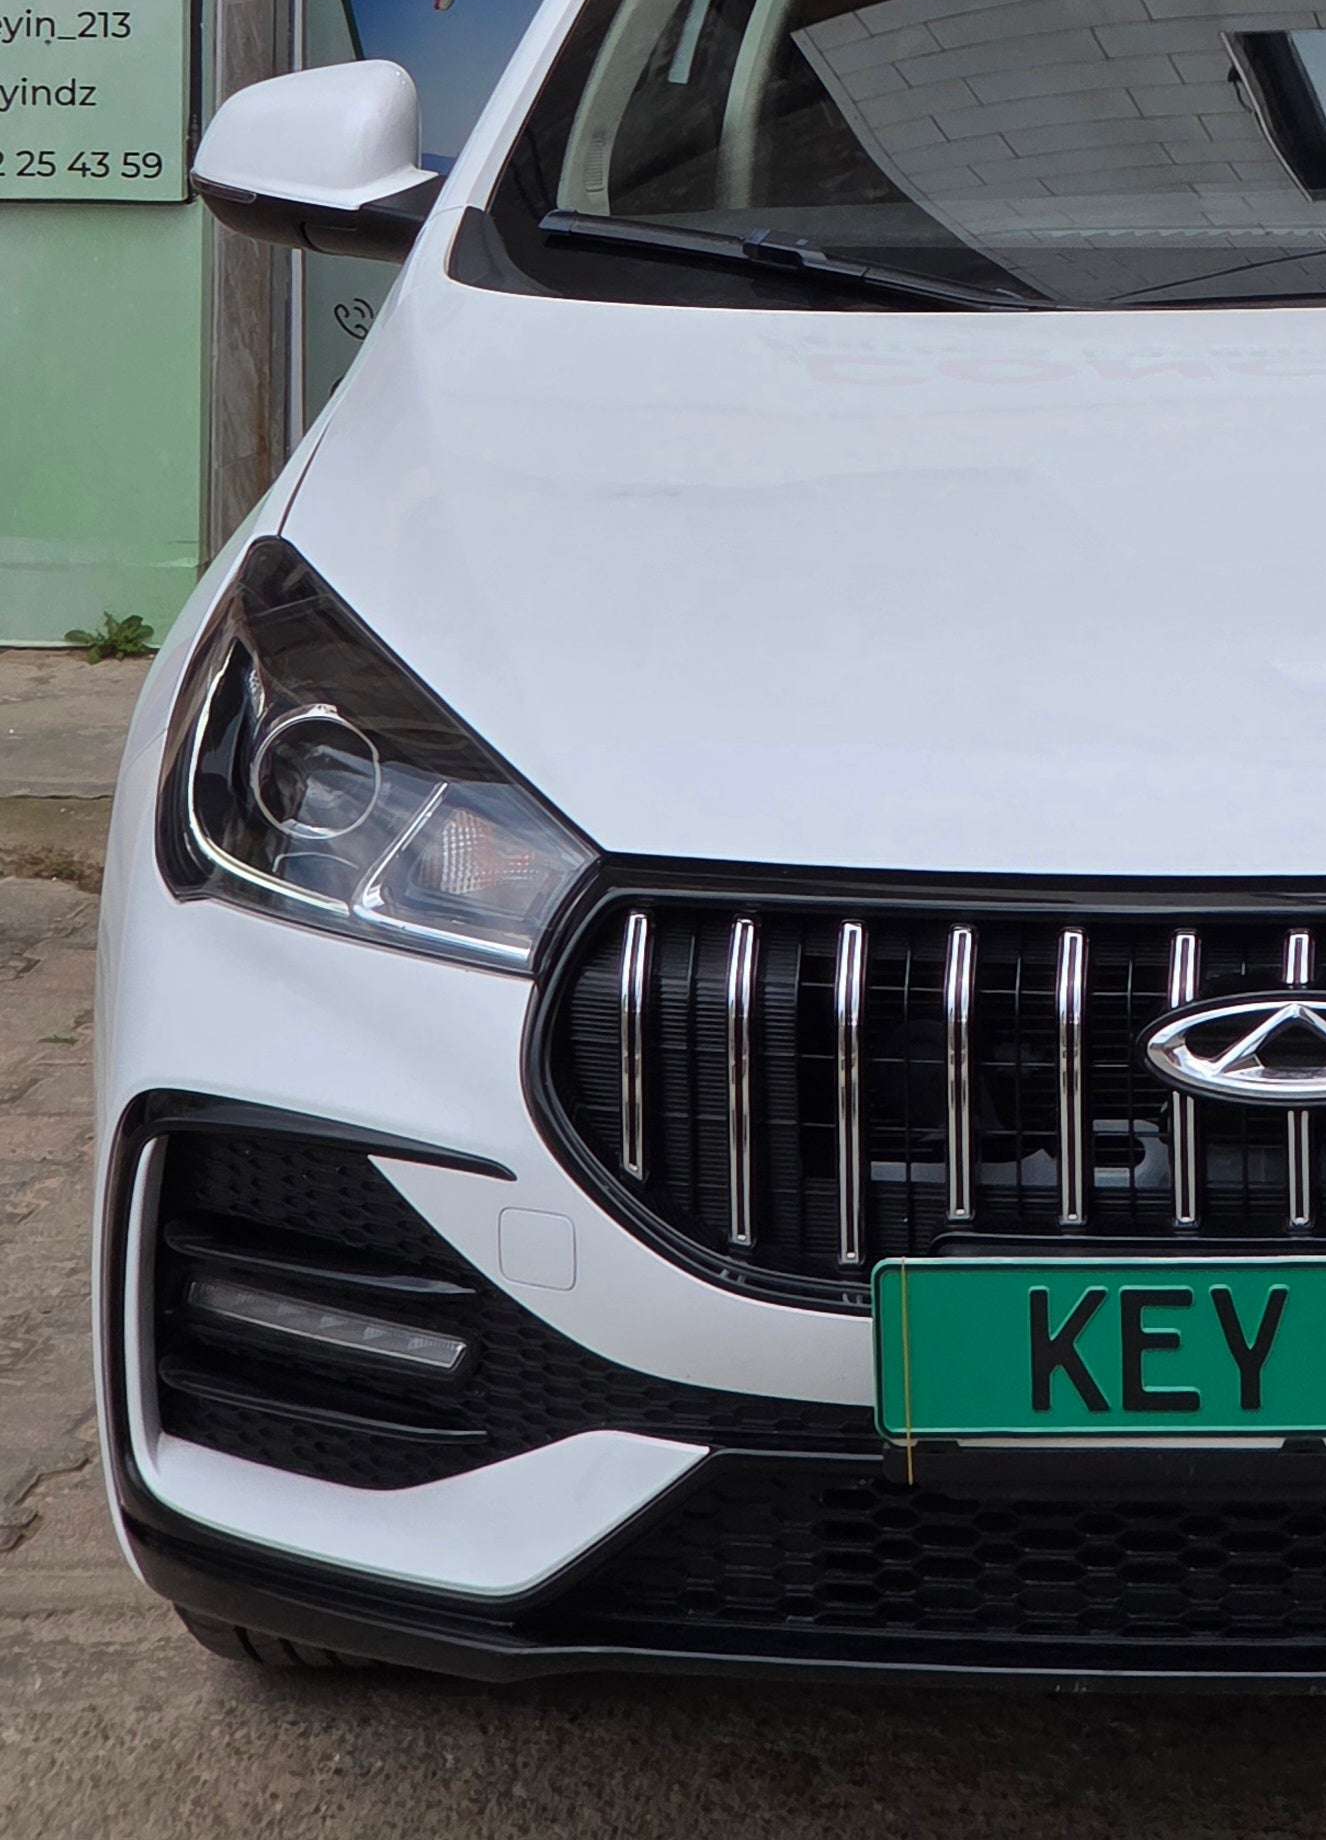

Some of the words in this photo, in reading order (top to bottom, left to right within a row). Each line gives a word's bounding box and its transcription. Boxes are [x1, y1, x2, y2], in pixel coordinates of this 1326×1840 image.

[0, 9, 131, 44] yin_213
[0, 77, 97, 112] yindz
[16, 150, 56, 177] 25
[67, 151, 110, 178] 43
[121, 152, 162, 178] 59
[1028, 1284, 1290, 1413] KEY
